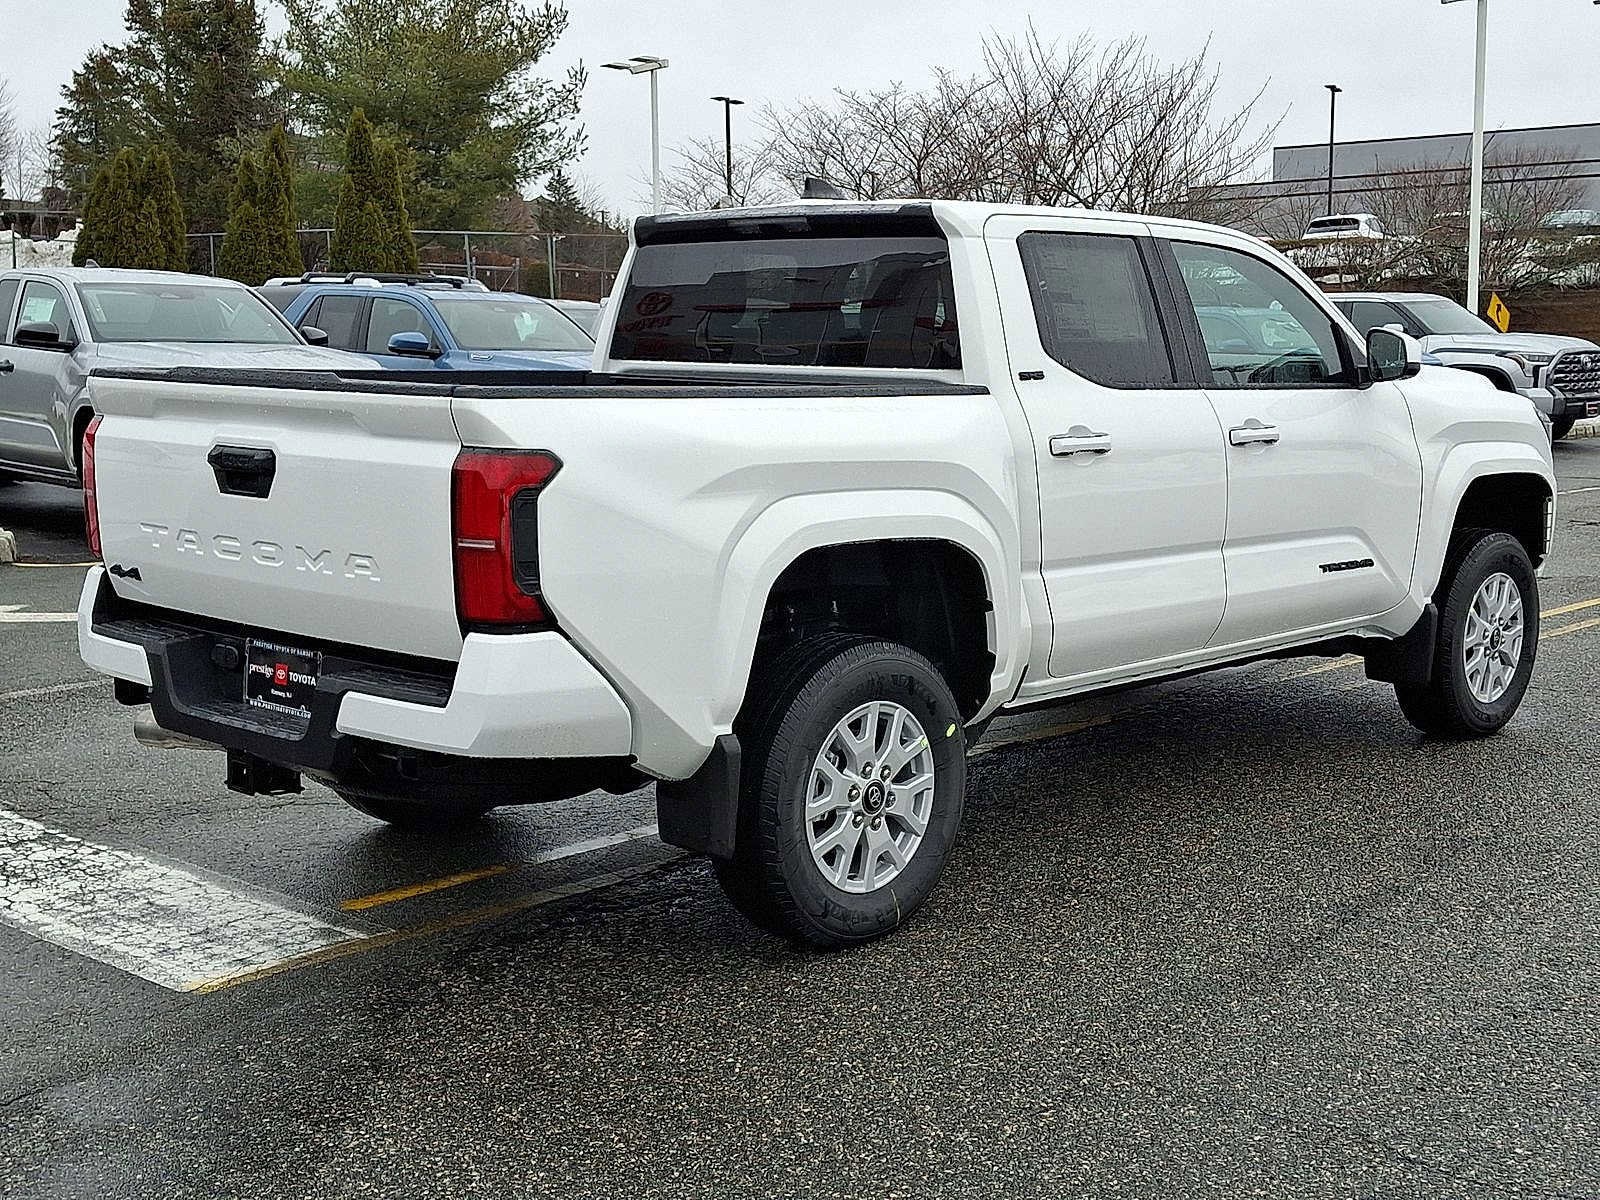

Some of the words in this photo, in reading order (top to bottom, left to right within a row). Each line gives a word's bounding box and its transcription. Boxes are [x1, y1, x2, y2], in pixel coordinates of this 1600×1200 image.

[139, 522, 381, 581] TACOMA
[1319, 559, 1375, 573] TACOMA
[249, 664, 274, 678] prestige
[288, 672, 317, 686] TOYOTA
